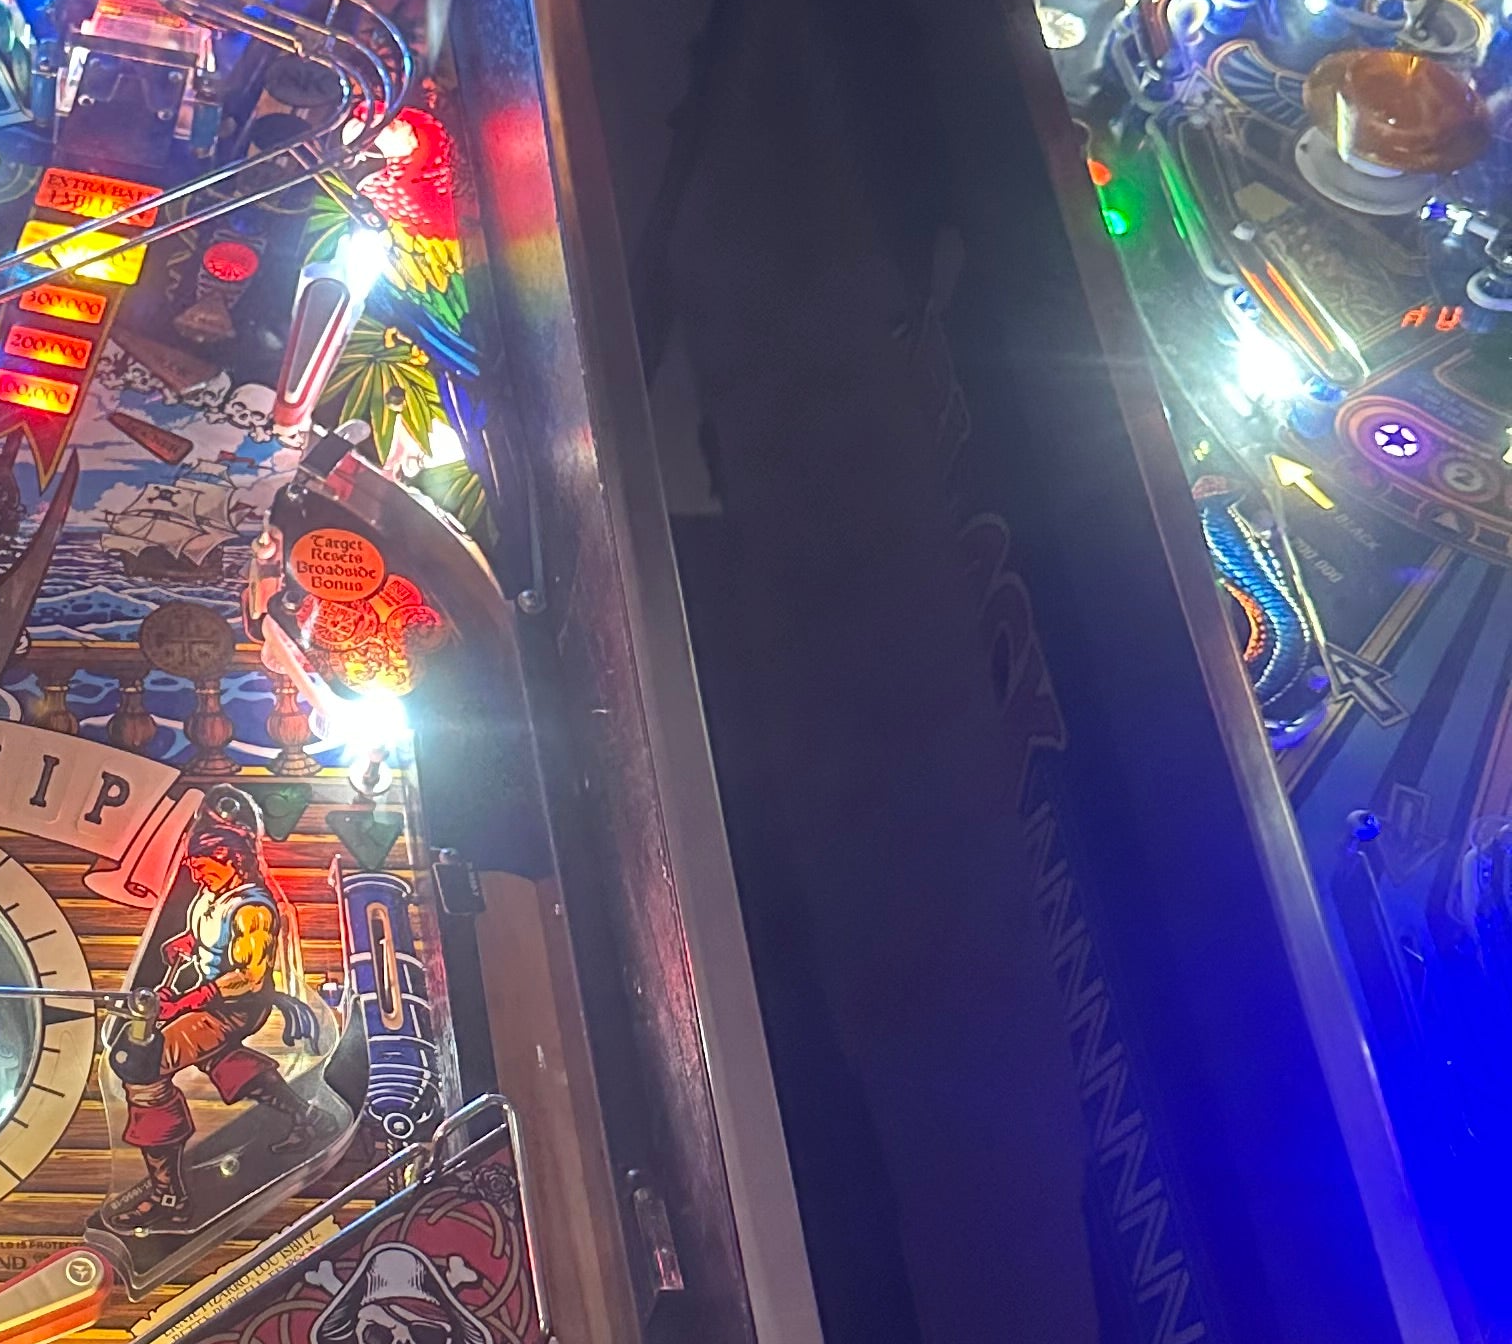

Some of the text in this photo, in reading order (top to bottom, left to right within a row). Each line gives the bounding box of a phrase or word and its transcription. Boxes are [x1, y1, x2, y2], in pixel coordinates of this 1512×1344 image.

[310, 535, 364, 553] Target
[311, 548, 363, 564] Resets
[296, 561, 376, 579] Broadside
[311, 576, 364, 592] Bonus
[255, 1255, 280, 1280] LOU
